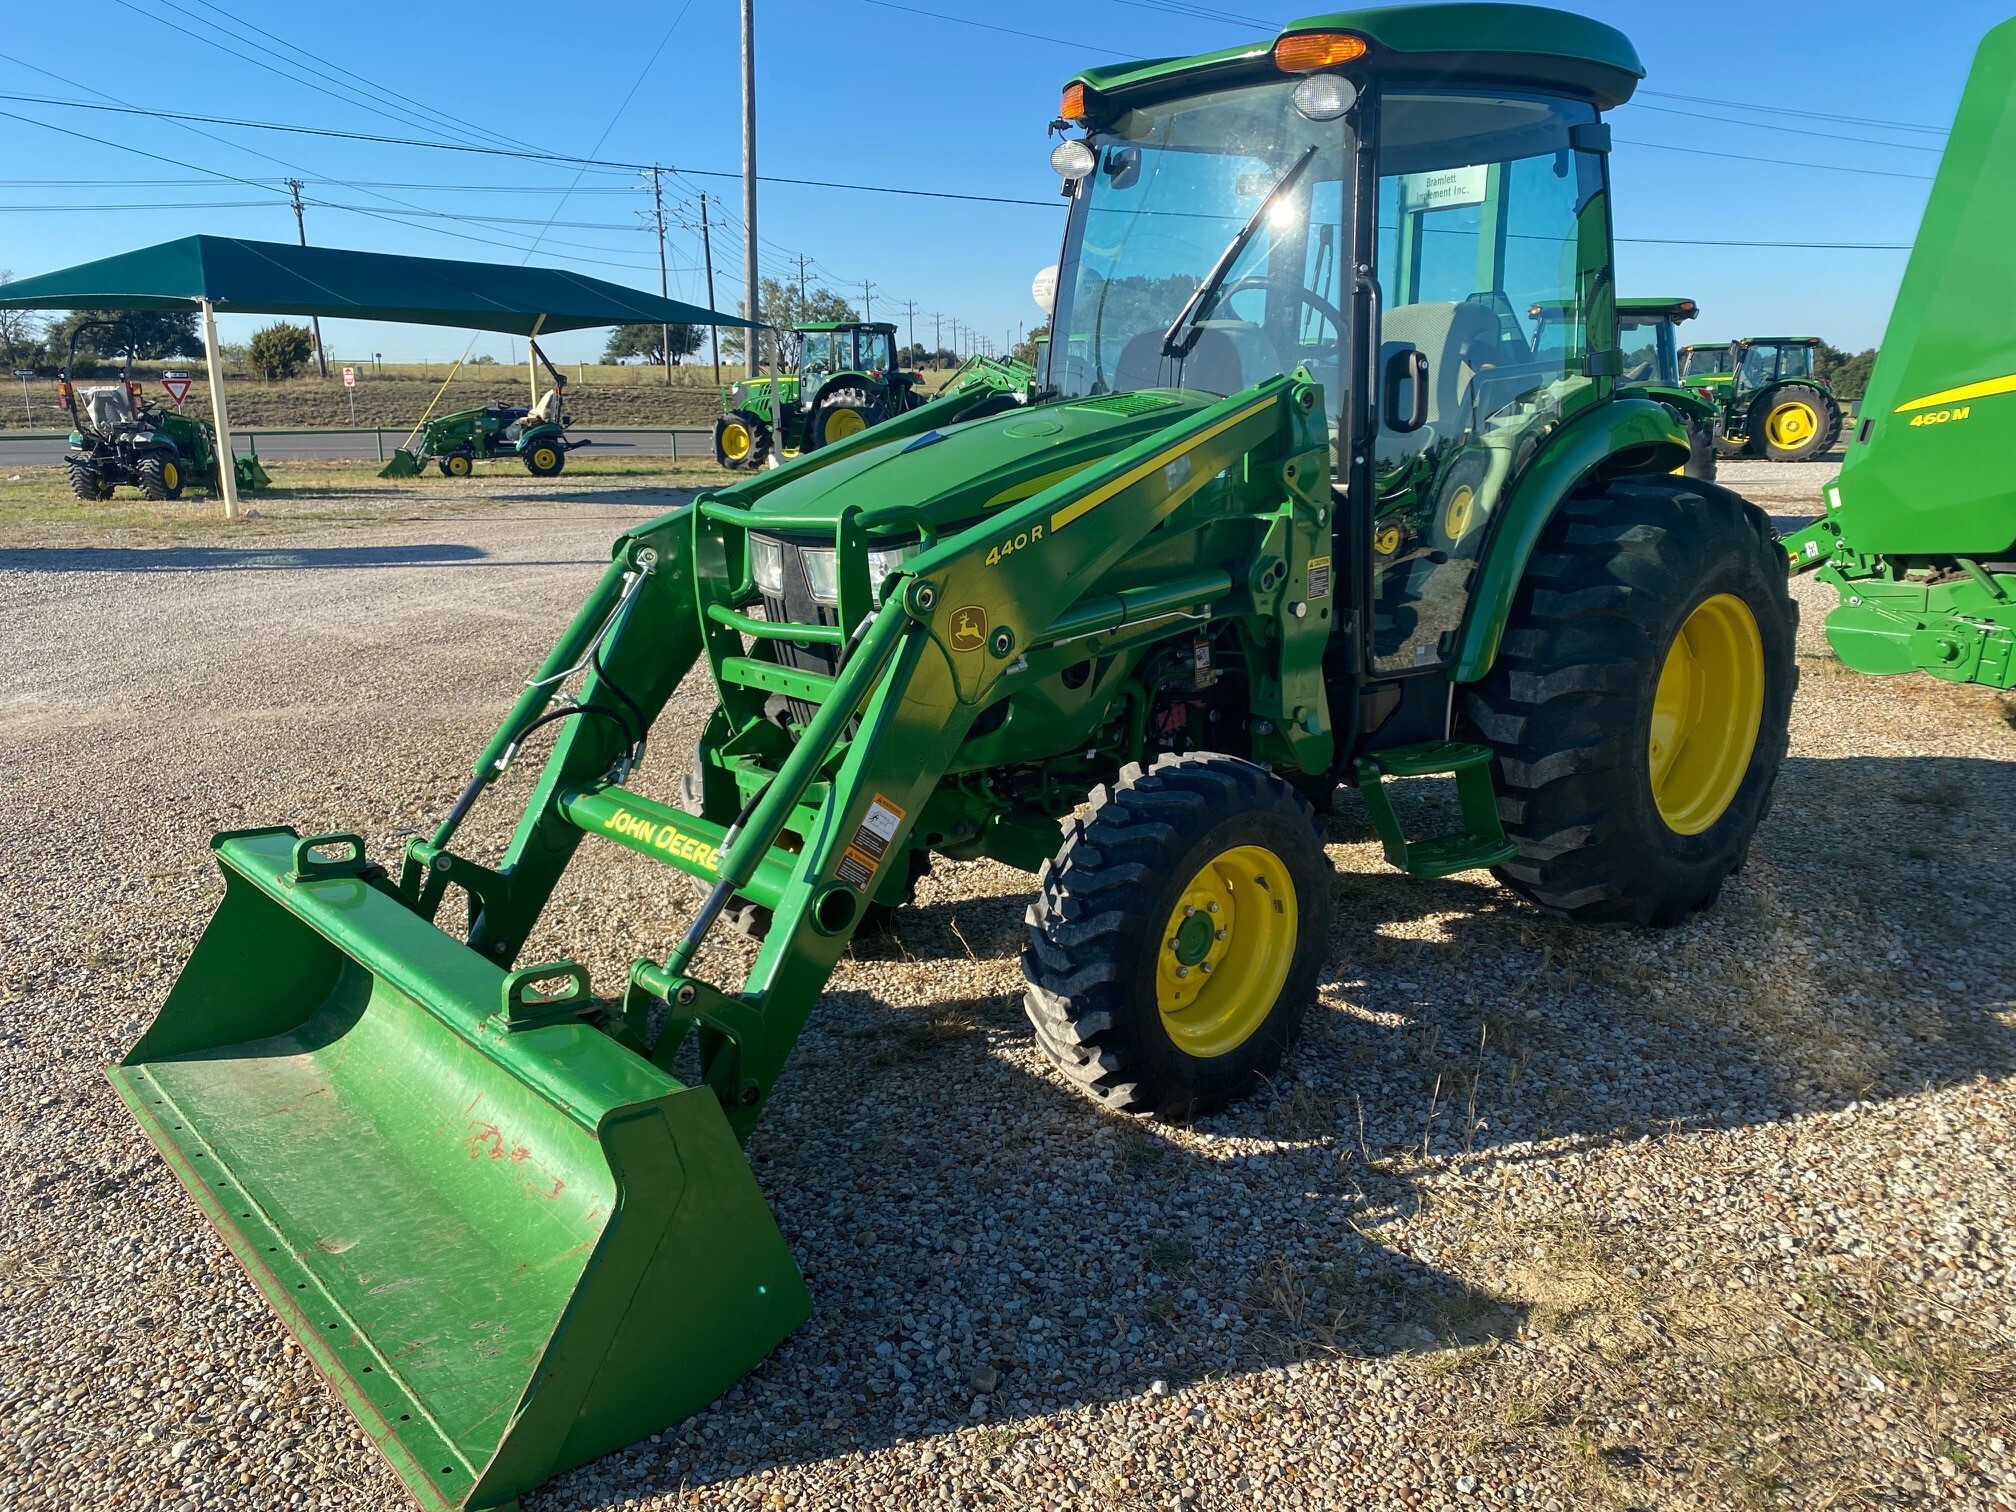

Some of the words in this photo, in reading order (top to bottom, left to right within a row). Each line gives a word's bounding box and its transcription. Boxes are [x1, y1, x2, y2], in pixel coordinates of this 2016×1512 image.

[1426, 174, 1457, 188] Bramlett
[1453, 185, 1470, 196] Inc.
[985, 533, 1028, 567] 440
[605, 808, 659, 844] JOHN
[655, 825, 719, 871] DEERE
